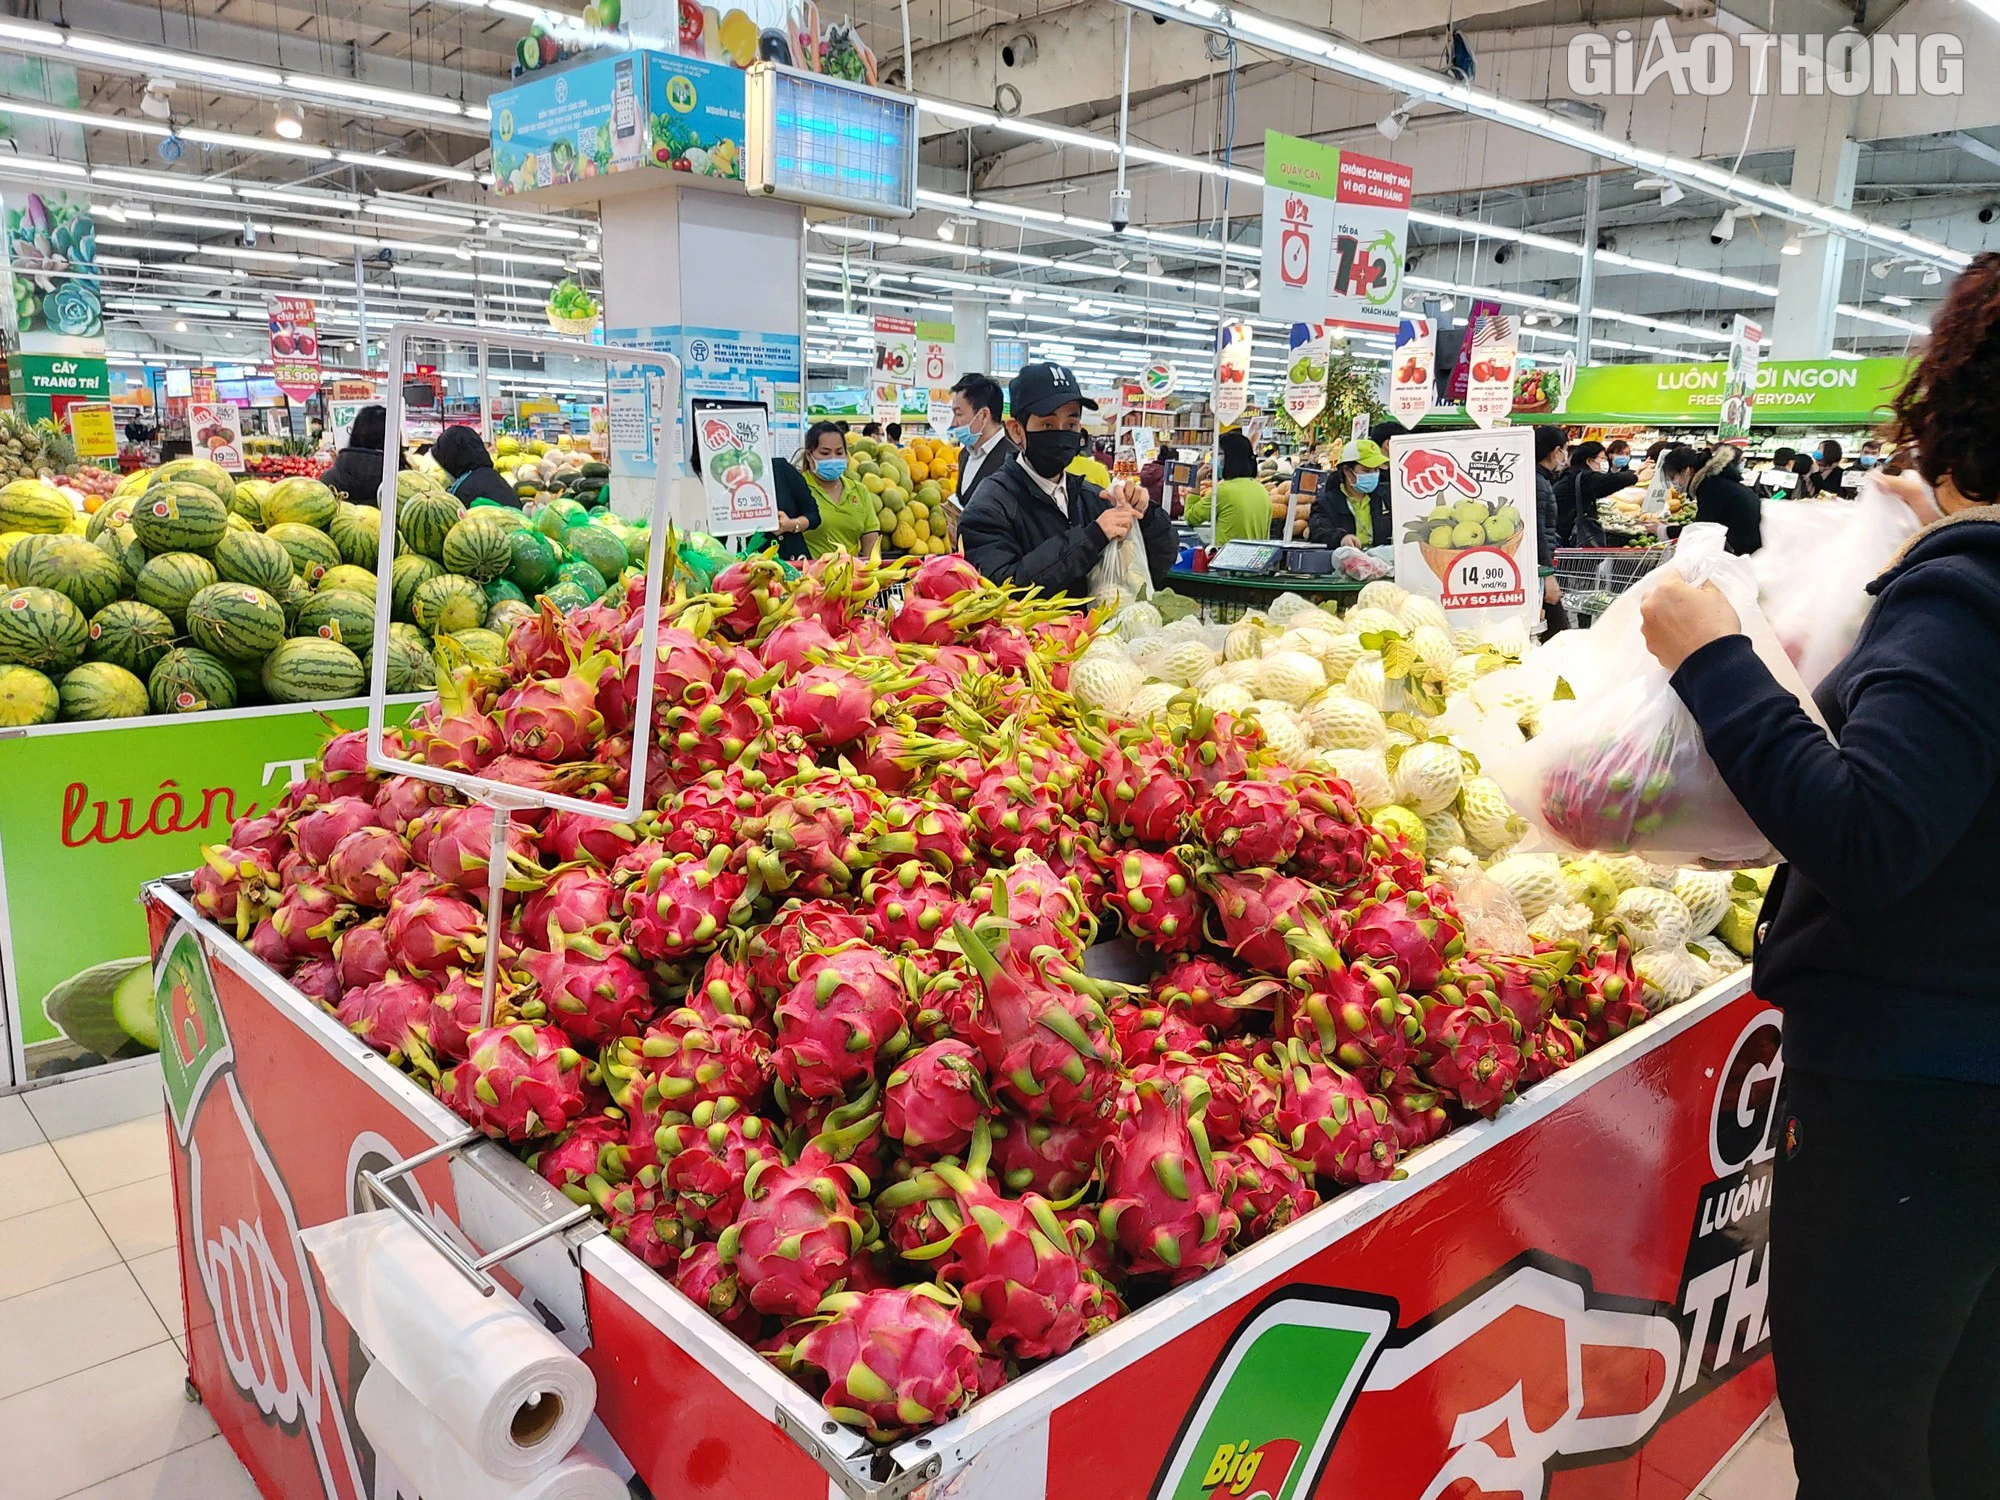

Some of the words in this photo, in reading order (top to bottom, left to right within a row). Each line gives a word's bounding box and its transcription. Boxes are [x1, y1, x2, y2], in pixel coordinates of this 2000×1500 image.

[1340, 162, 1367, 179] KHÔNG
[1368, 166, 1382, 182] CÒN
[1338, 225, 1349, 235] TỐI
[1350, 227, 1359, 236] ĐA
[1361, 306, 1382, 317] KHÁCH
[1382, 308, 1399, 318] HÀNG
[52, 361, 78, 374] CÂY
[32, 376, 76, 388] TRANG
[78, 376, 100, 389] TRÍ
[276, 370, 319, 382] 35.900
[1657, 368, 1717, 390] LUÔN
[1782, 367, 1857, 388] NGON
[1290, 400, 1304, 411] 39
[1401, 402, 1411, 410] 35
[1688, 394, 1724, 406] FRES
[1478, 404, 1488, 412] 35
[215, 452, 225, 462] 19
[1471, 448, 1500, 463] GIÁ
[1462, 566, 1479, 586] 14
[1442, 593, 1469, 608] HÃY
[1470, 596, 1488, 605] SO
[1489, 592, 1524, 604] SÁNH
[61, 778, 257, 848] luôn
[1699, 1175, 1768, 1238] LUÔN
[1202, 1439, 1263, 1493] Big
